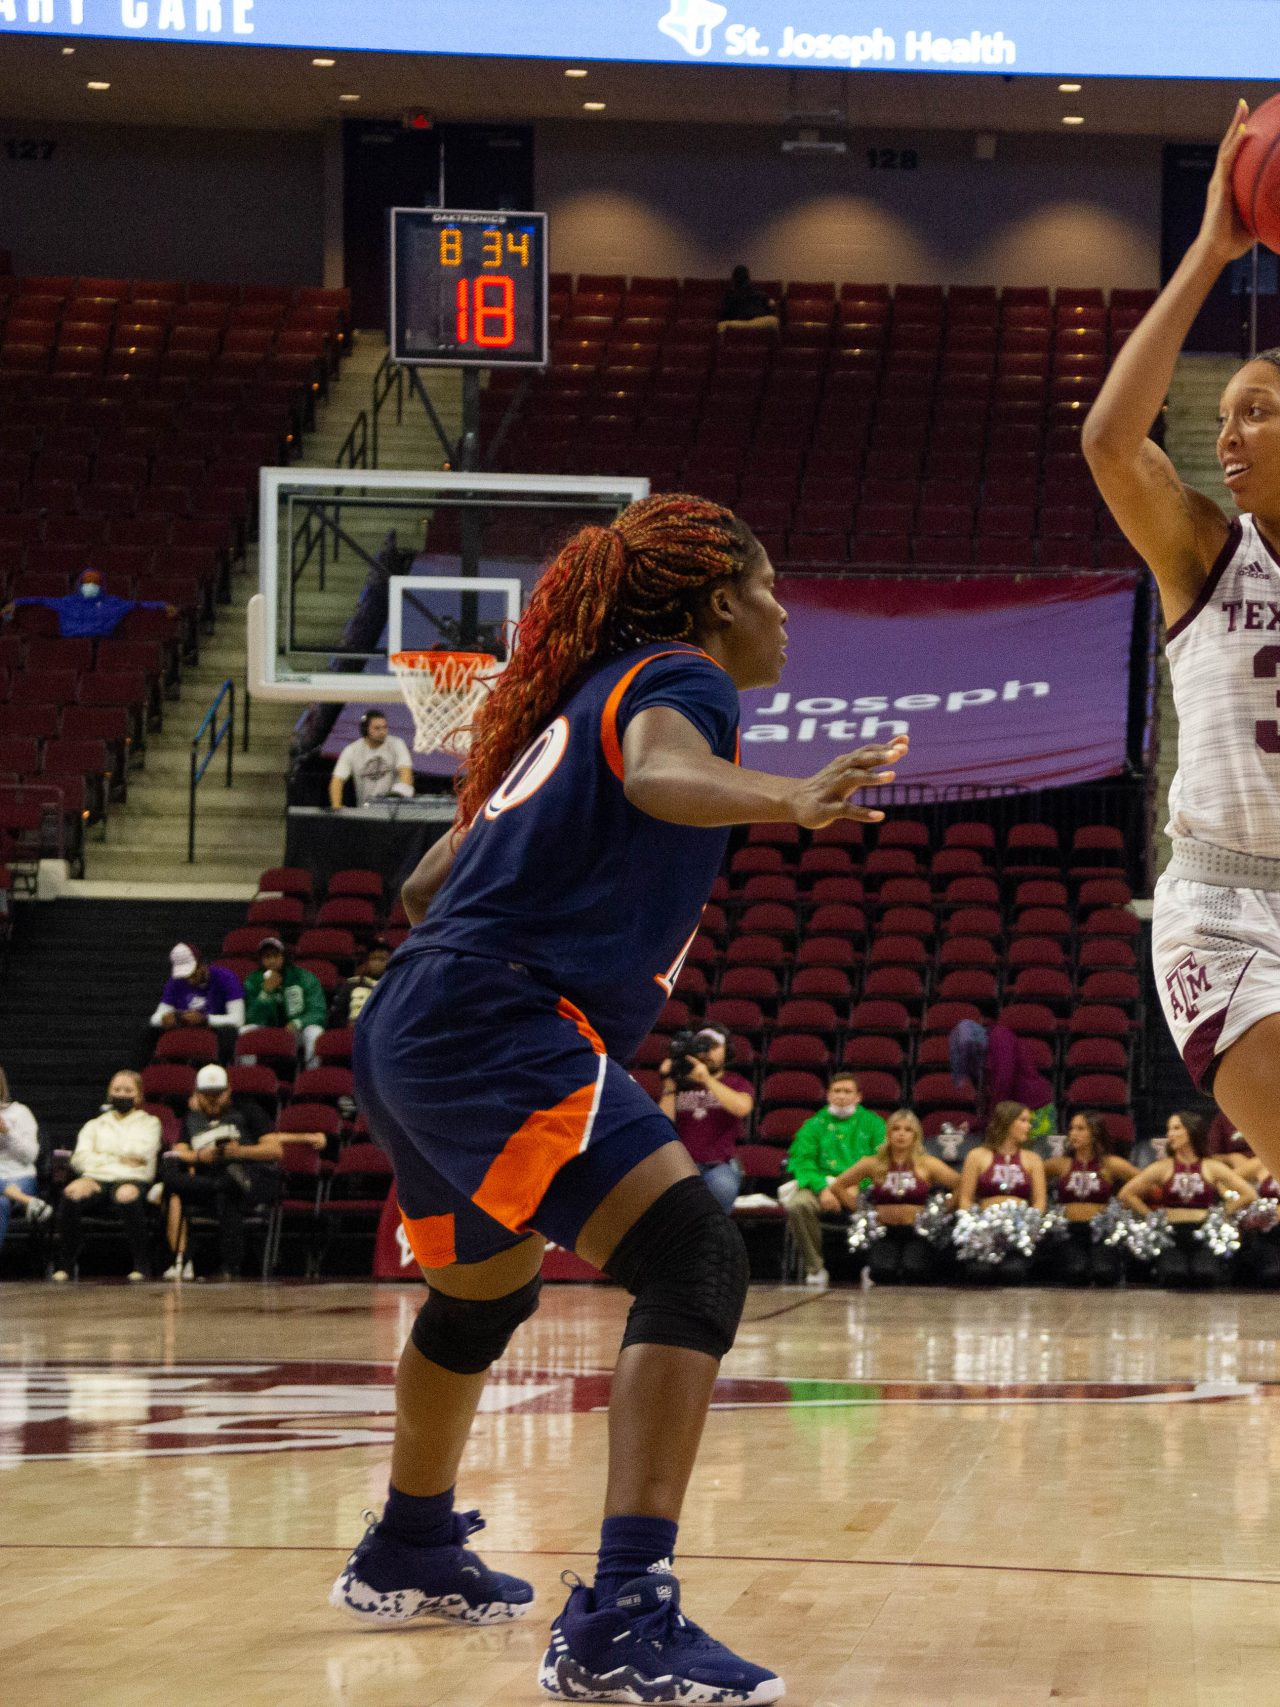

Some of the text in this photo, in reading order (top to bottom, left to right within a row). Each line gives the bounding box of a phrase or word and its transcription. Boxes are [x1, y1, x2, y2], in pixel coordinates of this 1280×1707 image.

[725, 24, 1016, 67] St. Joseph Health
[867, 148, 918, 170] 128
[432, 213, 507, 223] DAKTRONICS
[440, 229, 530, 268] 8 34
[456, 274, 515, 347] 18
[1237, 569, 1270, 580] adidas
[756, 680, 1051, 715] Joseph
[472, 715, 570, 828] 0
